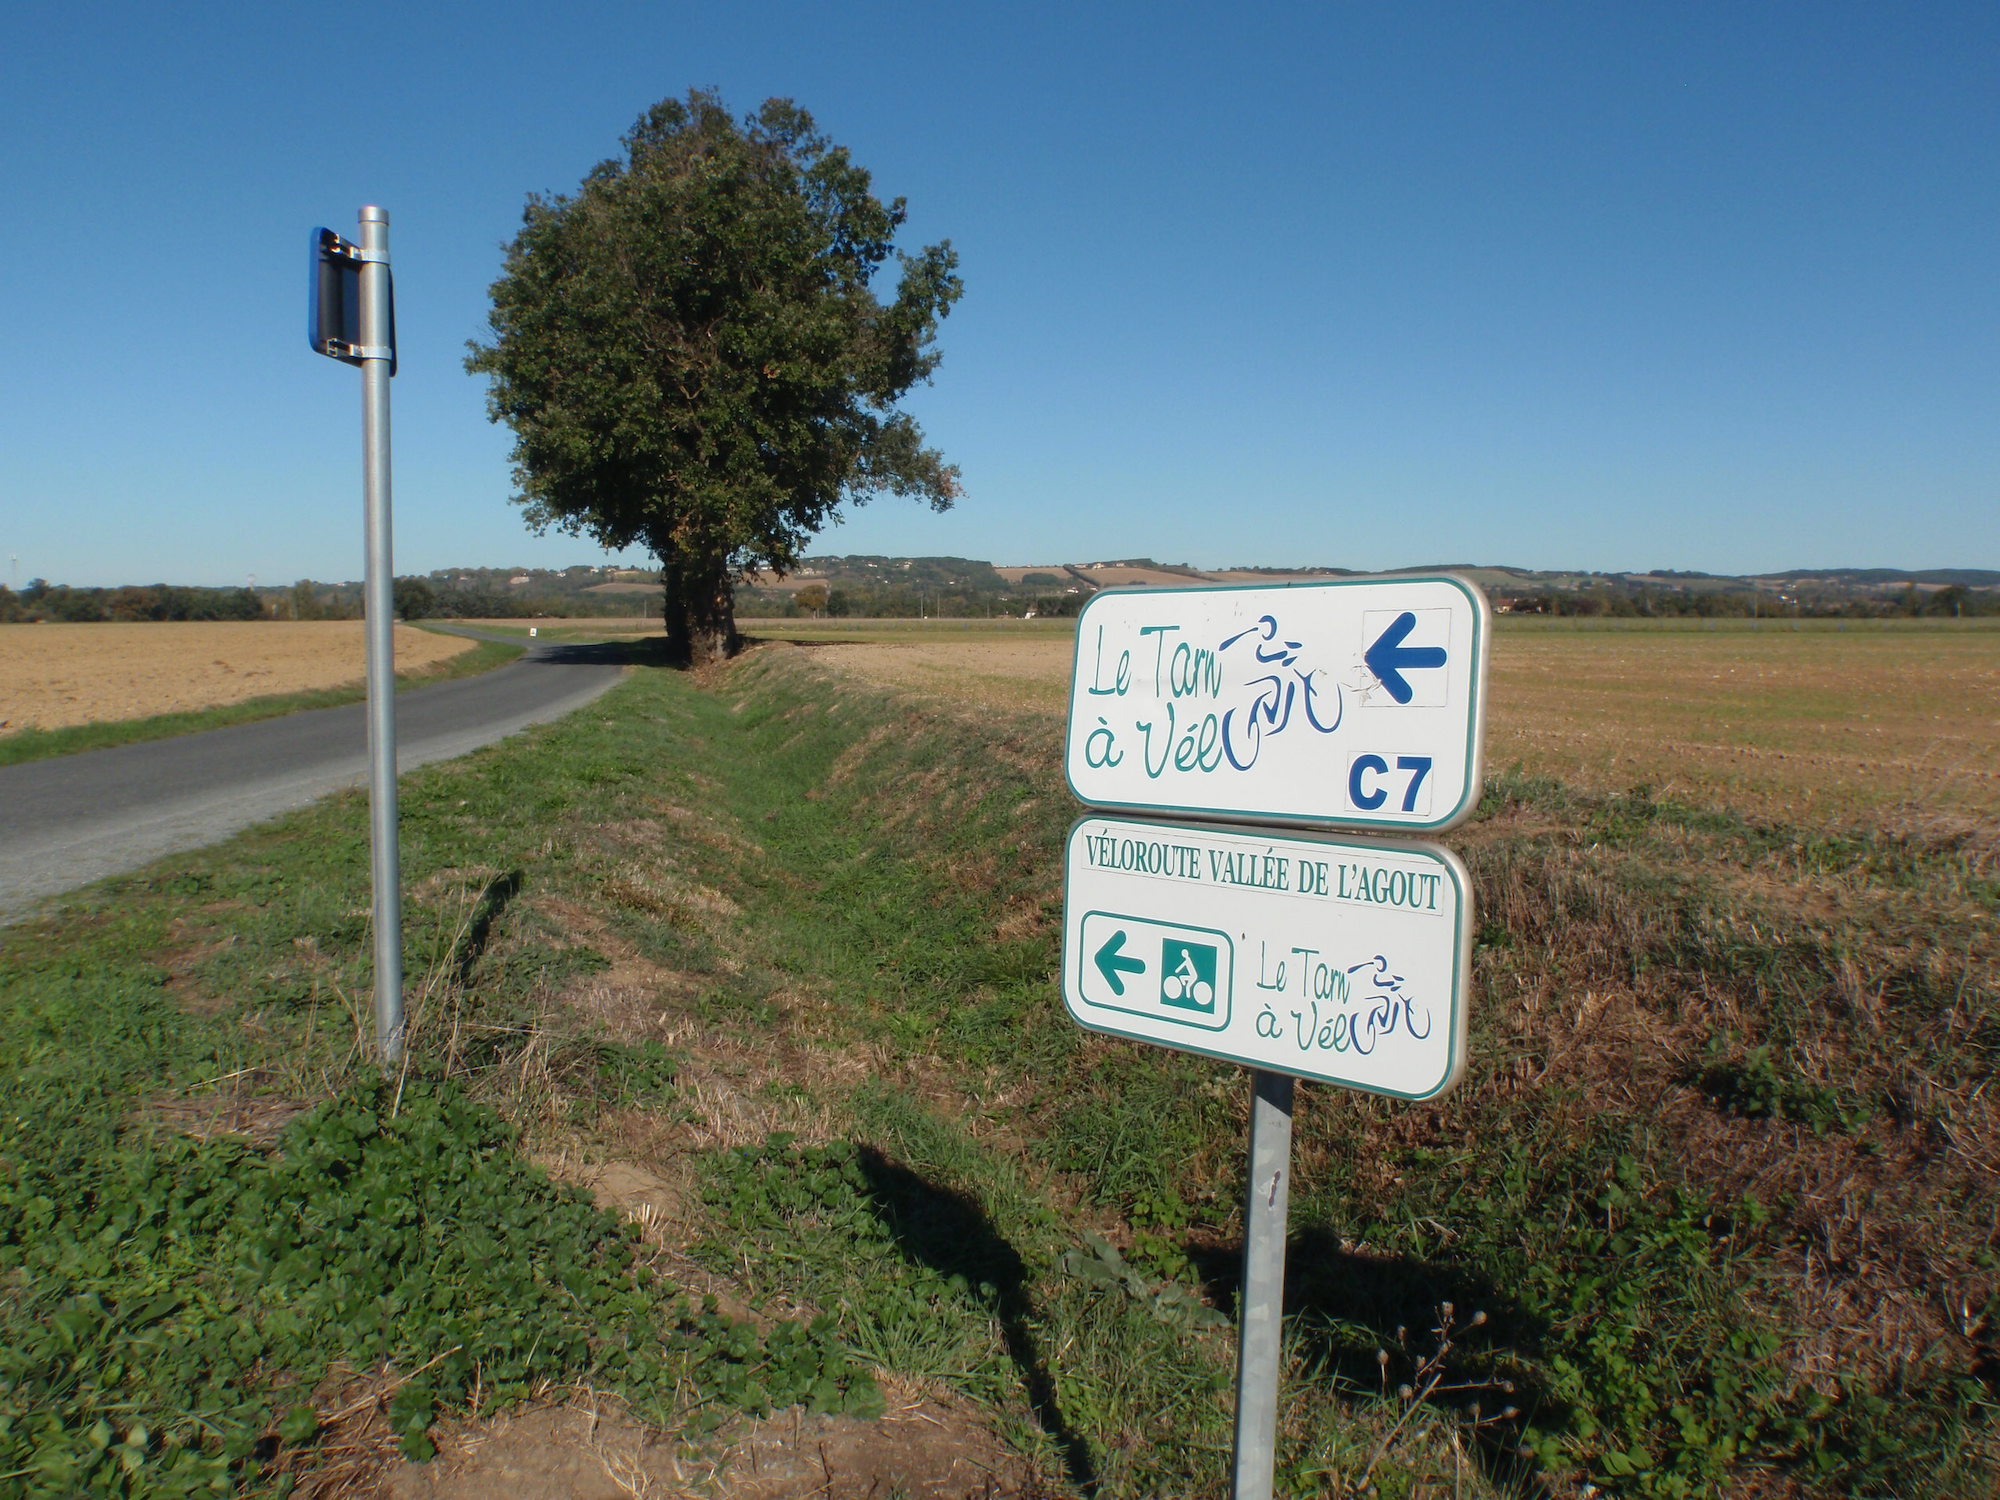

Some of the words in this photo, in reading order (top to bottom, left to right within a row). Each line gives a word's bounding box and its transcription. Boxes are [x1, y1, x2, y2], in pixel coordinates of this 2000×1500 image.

[1088, 624, 1132, 696] Le
[1140, 625, 1223, 699] Tarn
[1085, 716, 1124, 768] à
[1348, 753, 1432, 812] C7
[1086, 829, 1201, 879] VÉLOROUTE
[1208, 847, 1289, 891] VALLÉE
[1297, 859, 1329, 896] DE
[1337, 863, 1441, 911] L'AGOUT
[1256, 940, 1287, 993] Le
[1291, 947, 1350, 1005] Tarn
[1256, 1004, 1283, 1039] à
